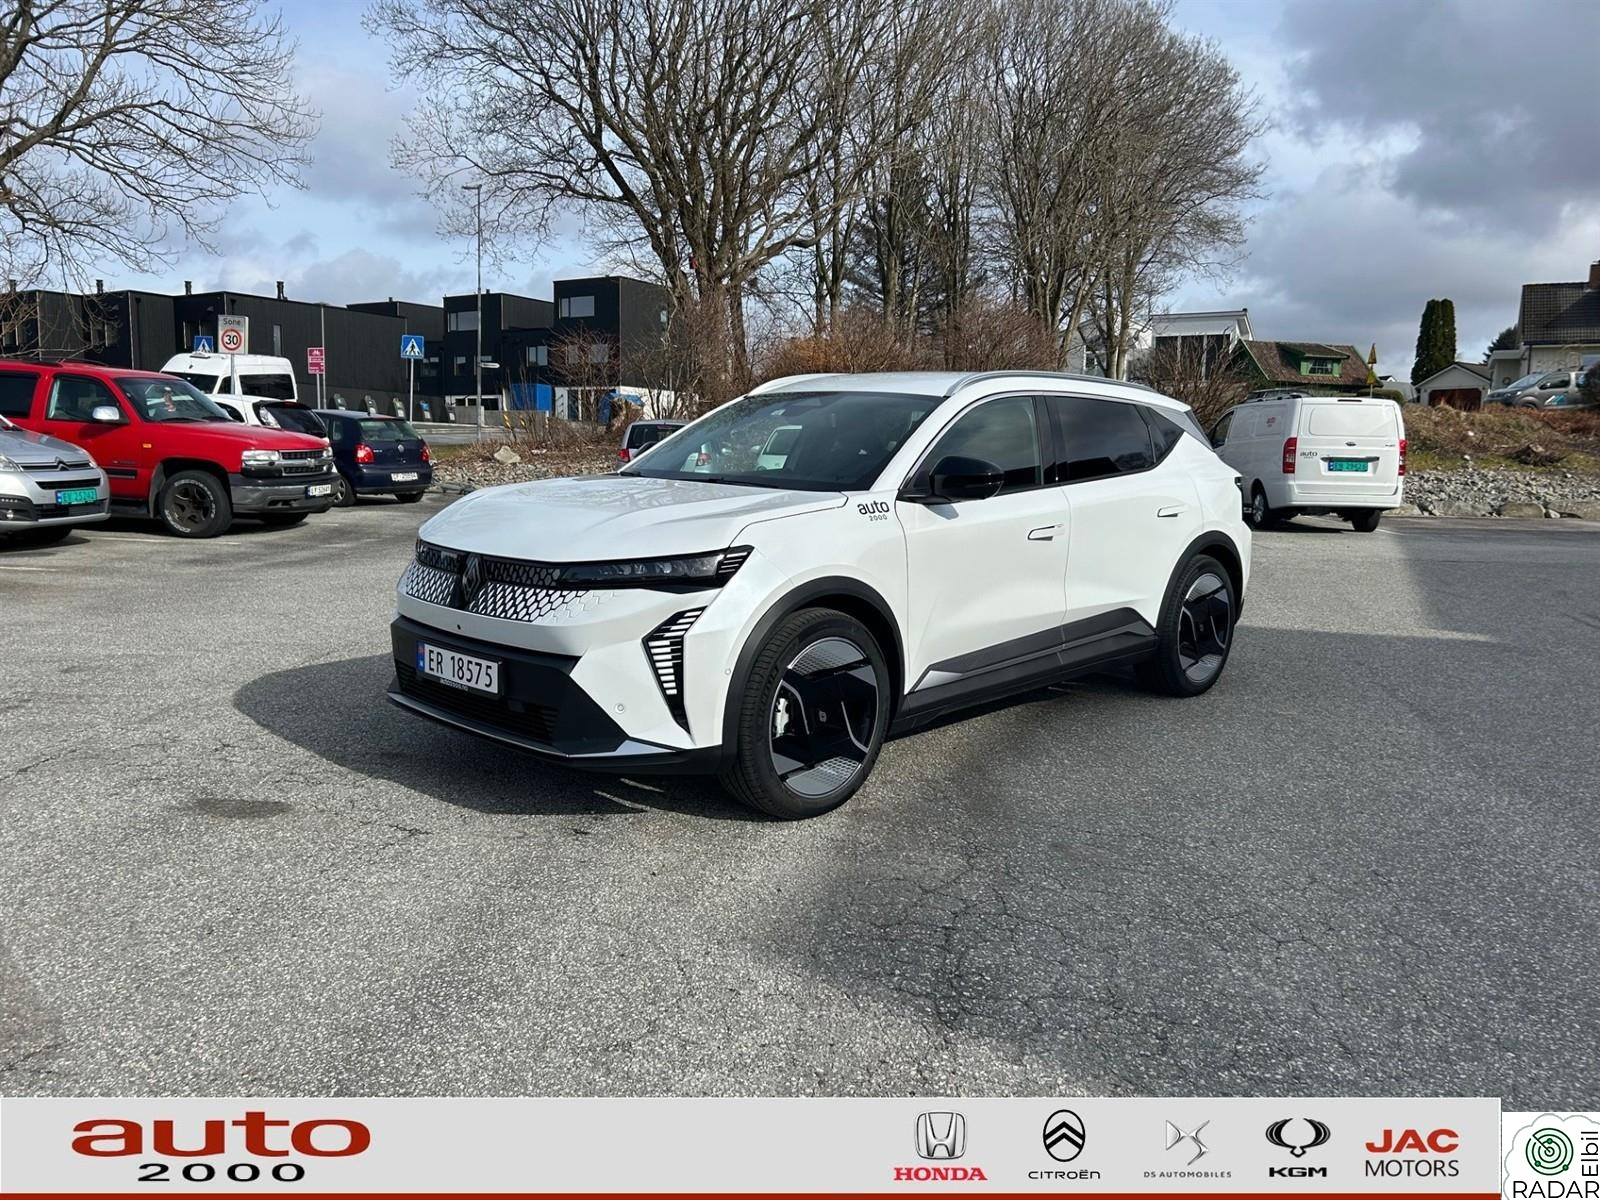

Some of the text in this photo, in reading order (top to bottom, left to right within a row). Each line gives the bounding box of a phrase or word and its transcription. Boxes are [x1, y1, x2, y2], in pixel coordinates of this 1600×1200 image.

[225, 334, 239, 346] 30
[857, 500, 890, 515] auto
[428, 649, 443, 674] ER
[450, 655, 493, 688] 18575
